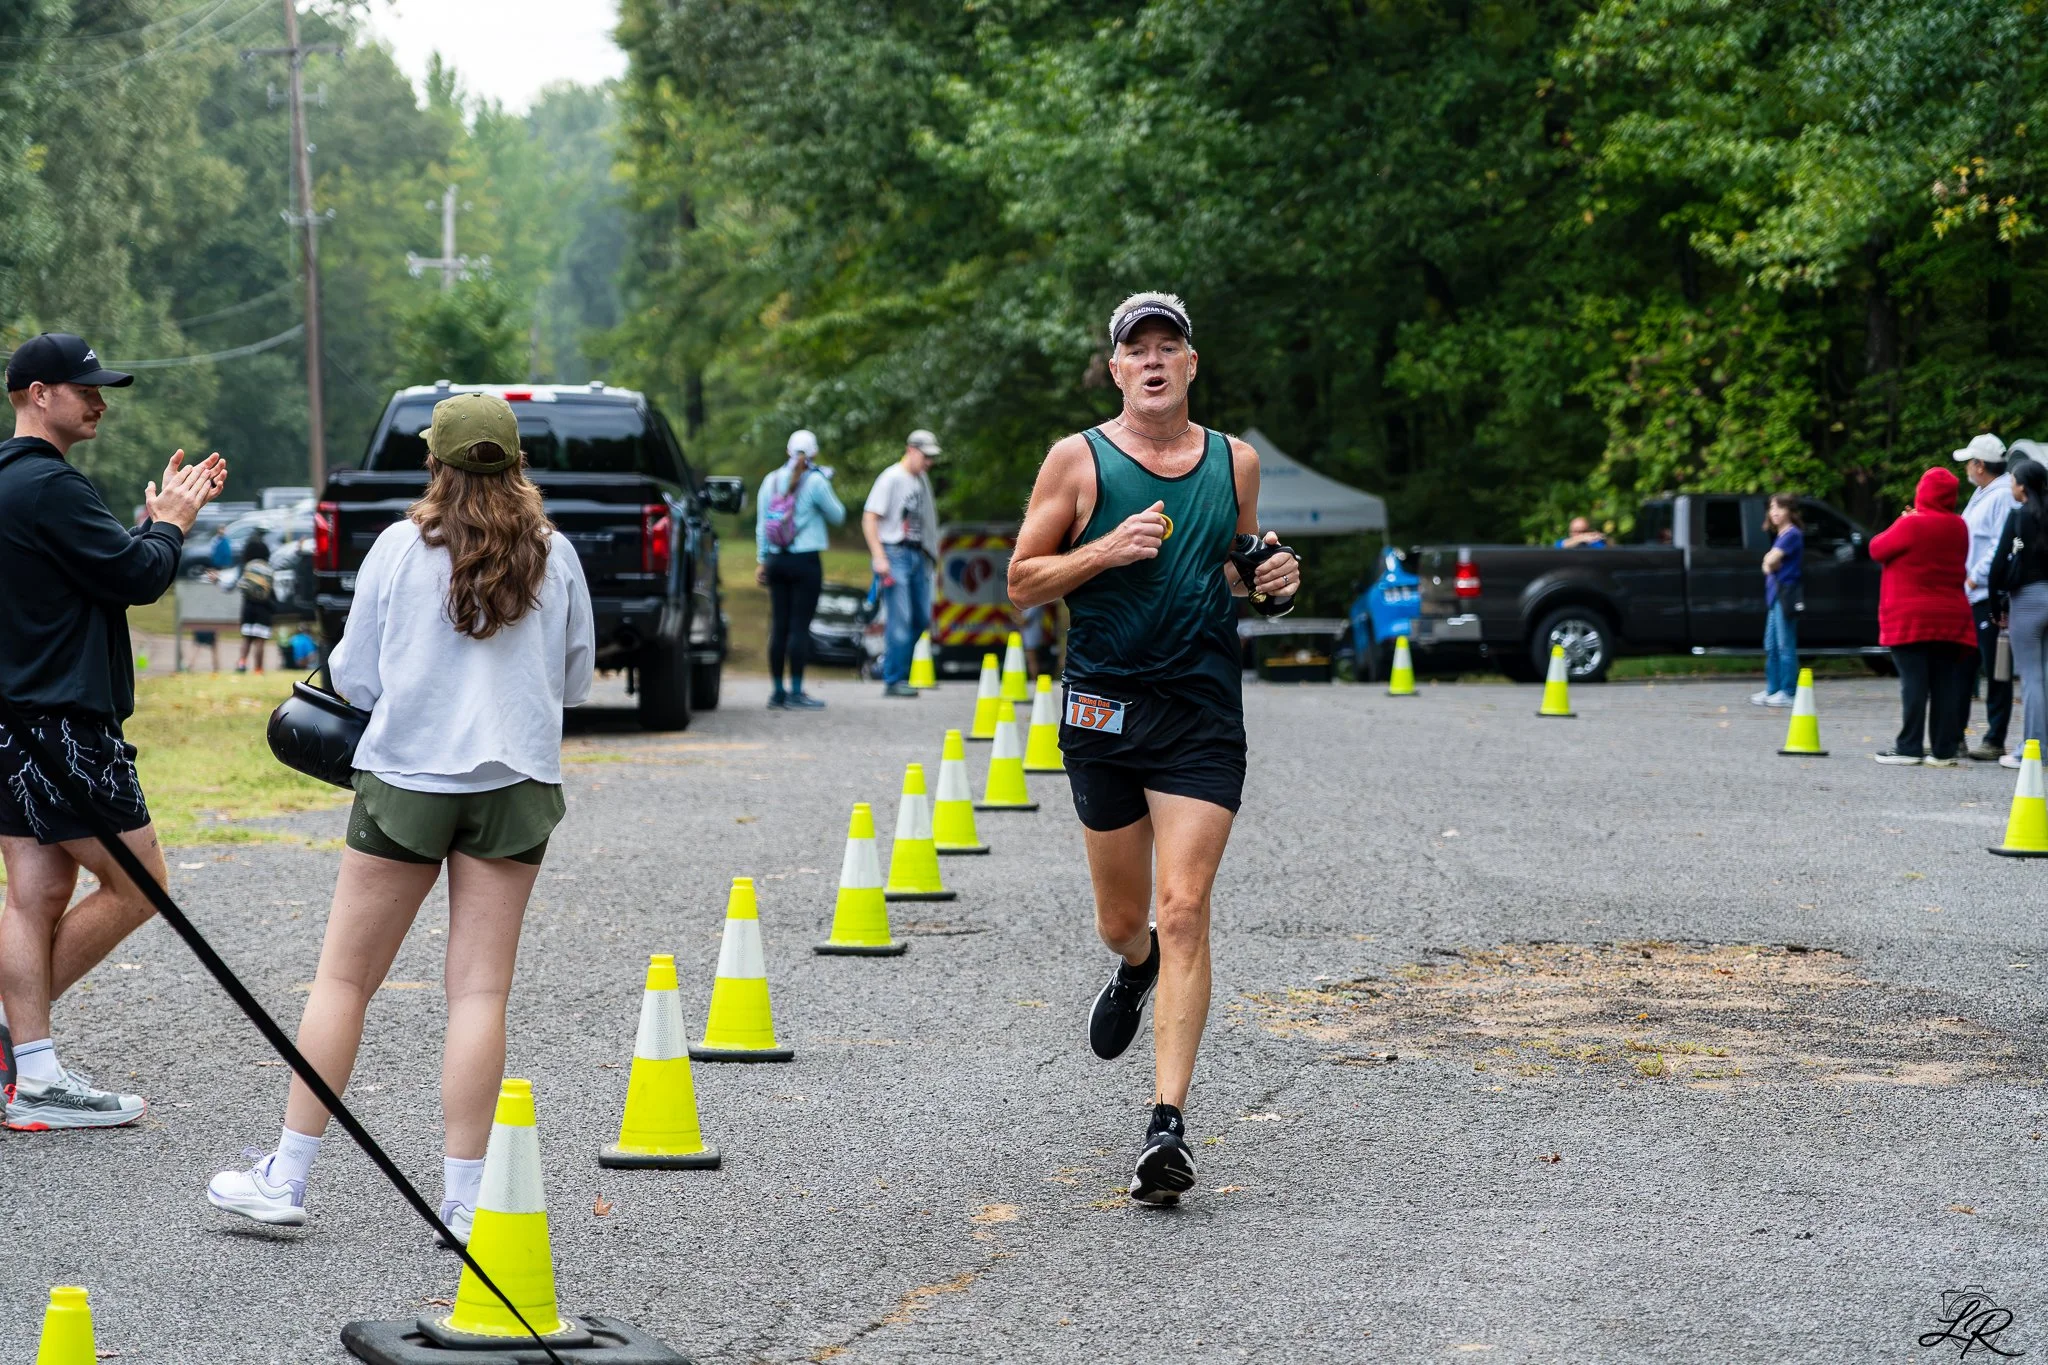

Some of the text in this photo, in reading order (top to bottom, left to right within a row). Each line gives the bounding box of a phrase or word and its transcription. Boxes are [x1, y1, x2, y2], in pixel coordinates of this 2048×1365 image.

[1133, 306, 1178, 321] RAGNAR TRAIL
[1078, 695, 1111, 708] Viking Dad
[1070, 703, 1115, 730] 157
